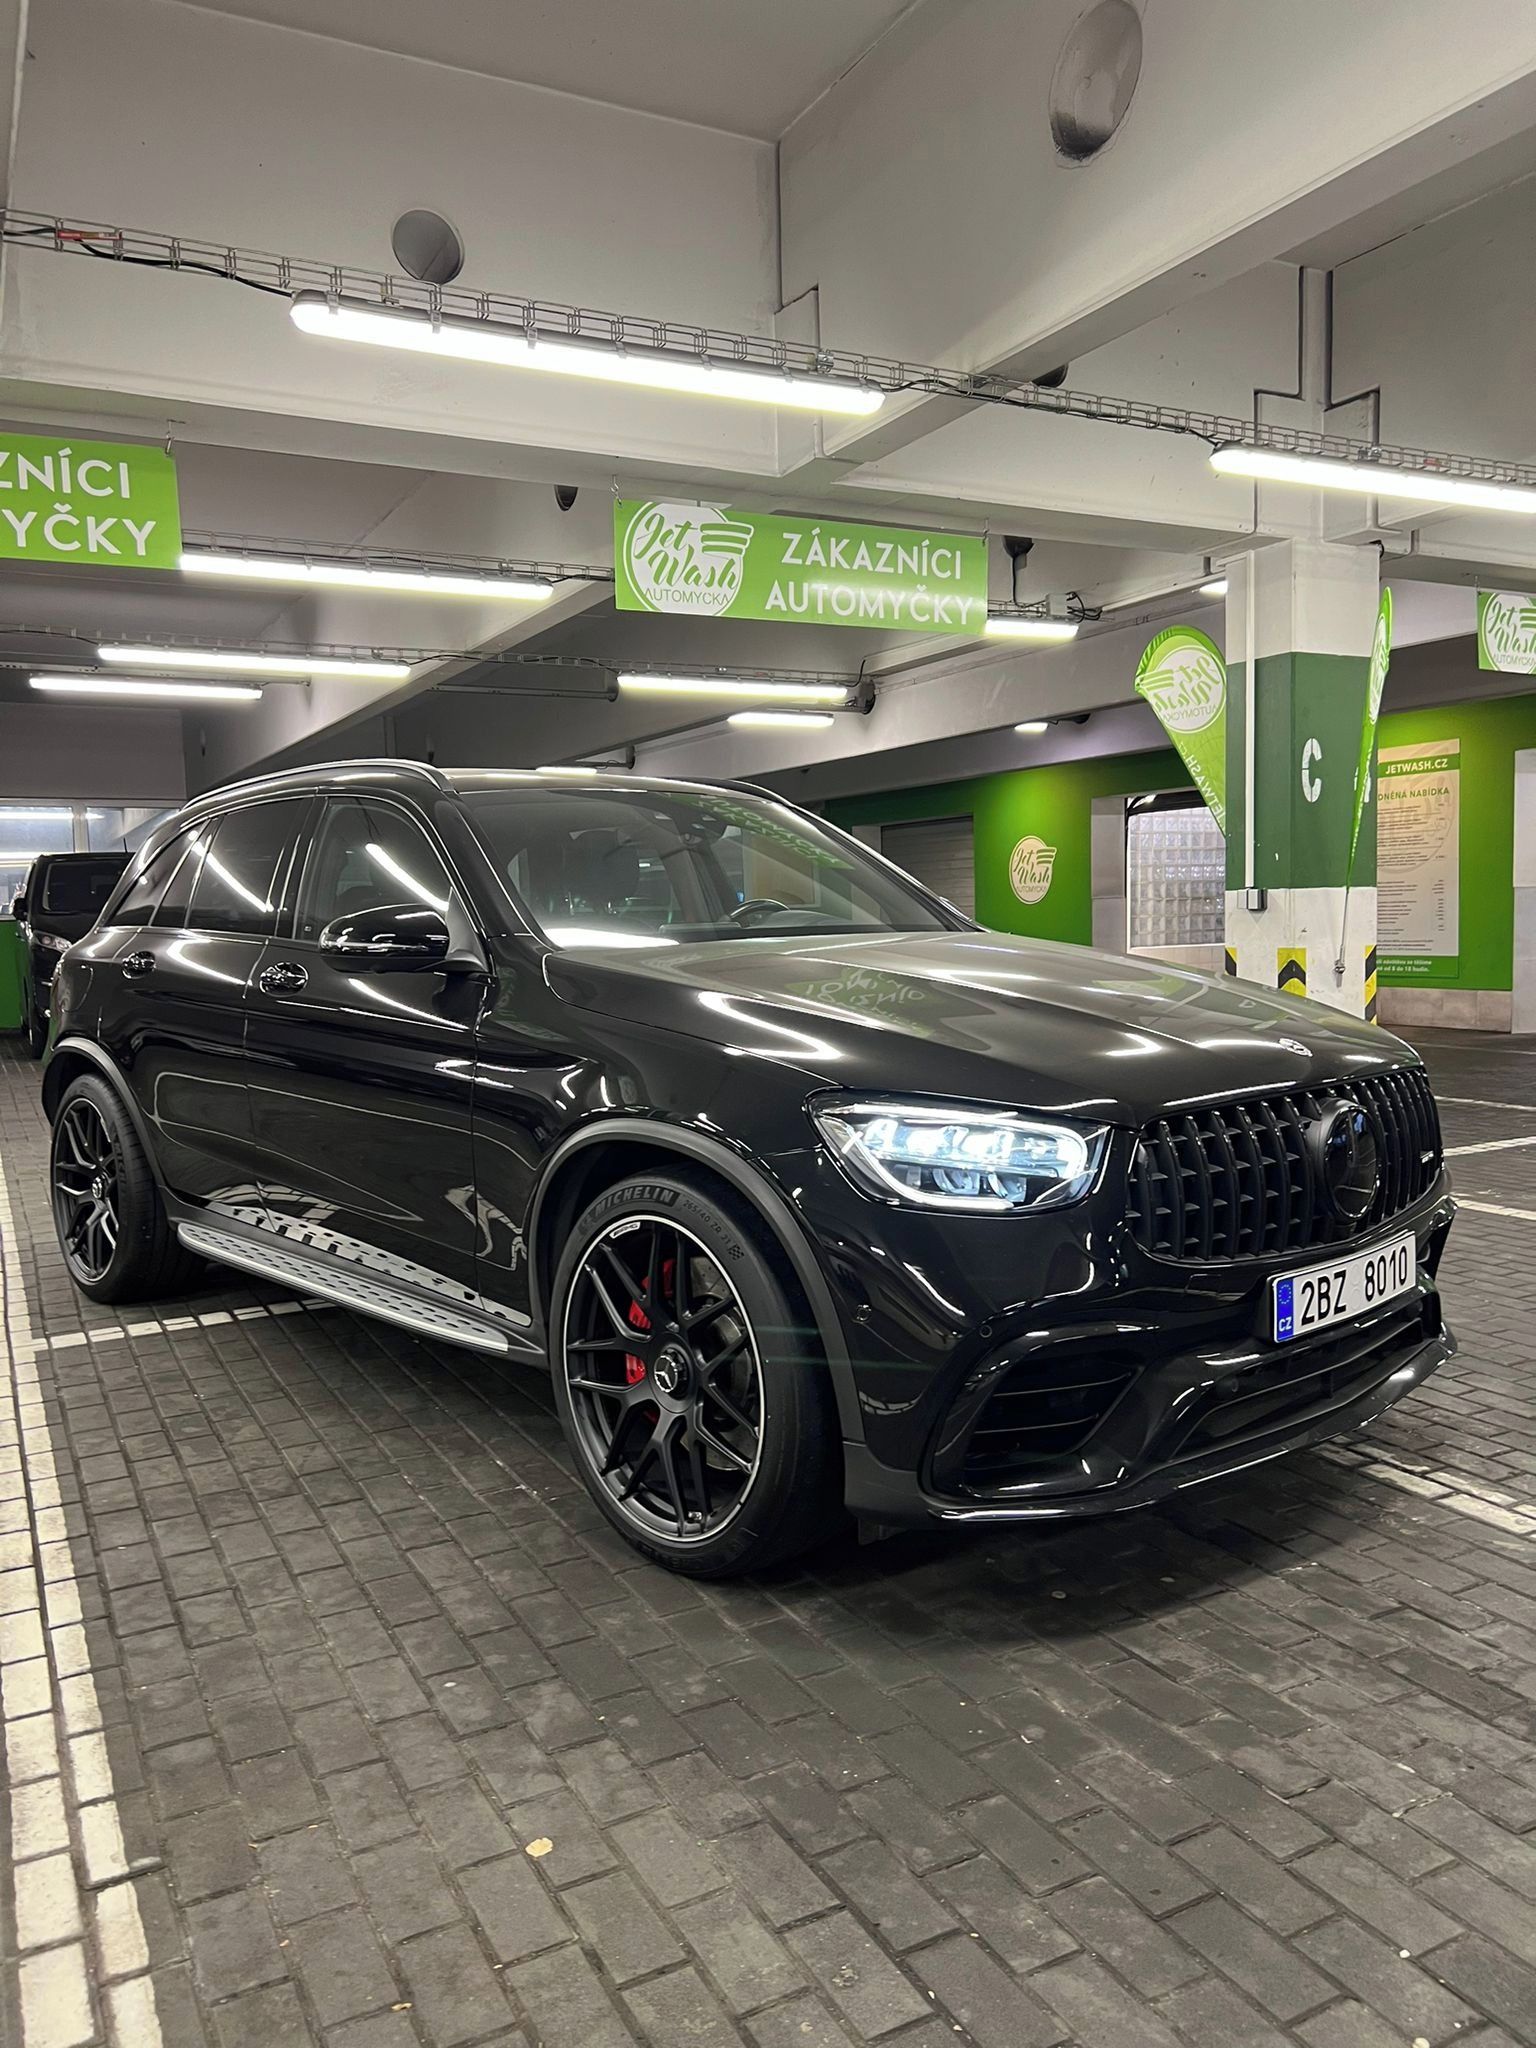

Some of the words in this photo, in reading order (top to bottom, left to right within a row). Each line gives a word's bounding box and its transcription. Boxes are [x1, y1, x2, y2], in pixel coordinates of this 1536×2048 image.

[634, 513, 698, 559] Jet
[781, 527, 961, 579] ZÁKAZNÍCI
[648, 544, 739, 590] Wash
[765, 579, 973, 625] AUTOMYČKY
[1301, 737, 1322, 802] C
[1386, 758, 1448, 774] JETWASH.CZ
[1410, 786, 1449, 798] NABÍDKA
[595, 1186, 674, 1215] MICHELIN
[1301, 1269, 1347, 1326] 2BZ
[1364, 1245, 1408, 1302] 8010
[1278, 1316, 1292, 1332] CZ
